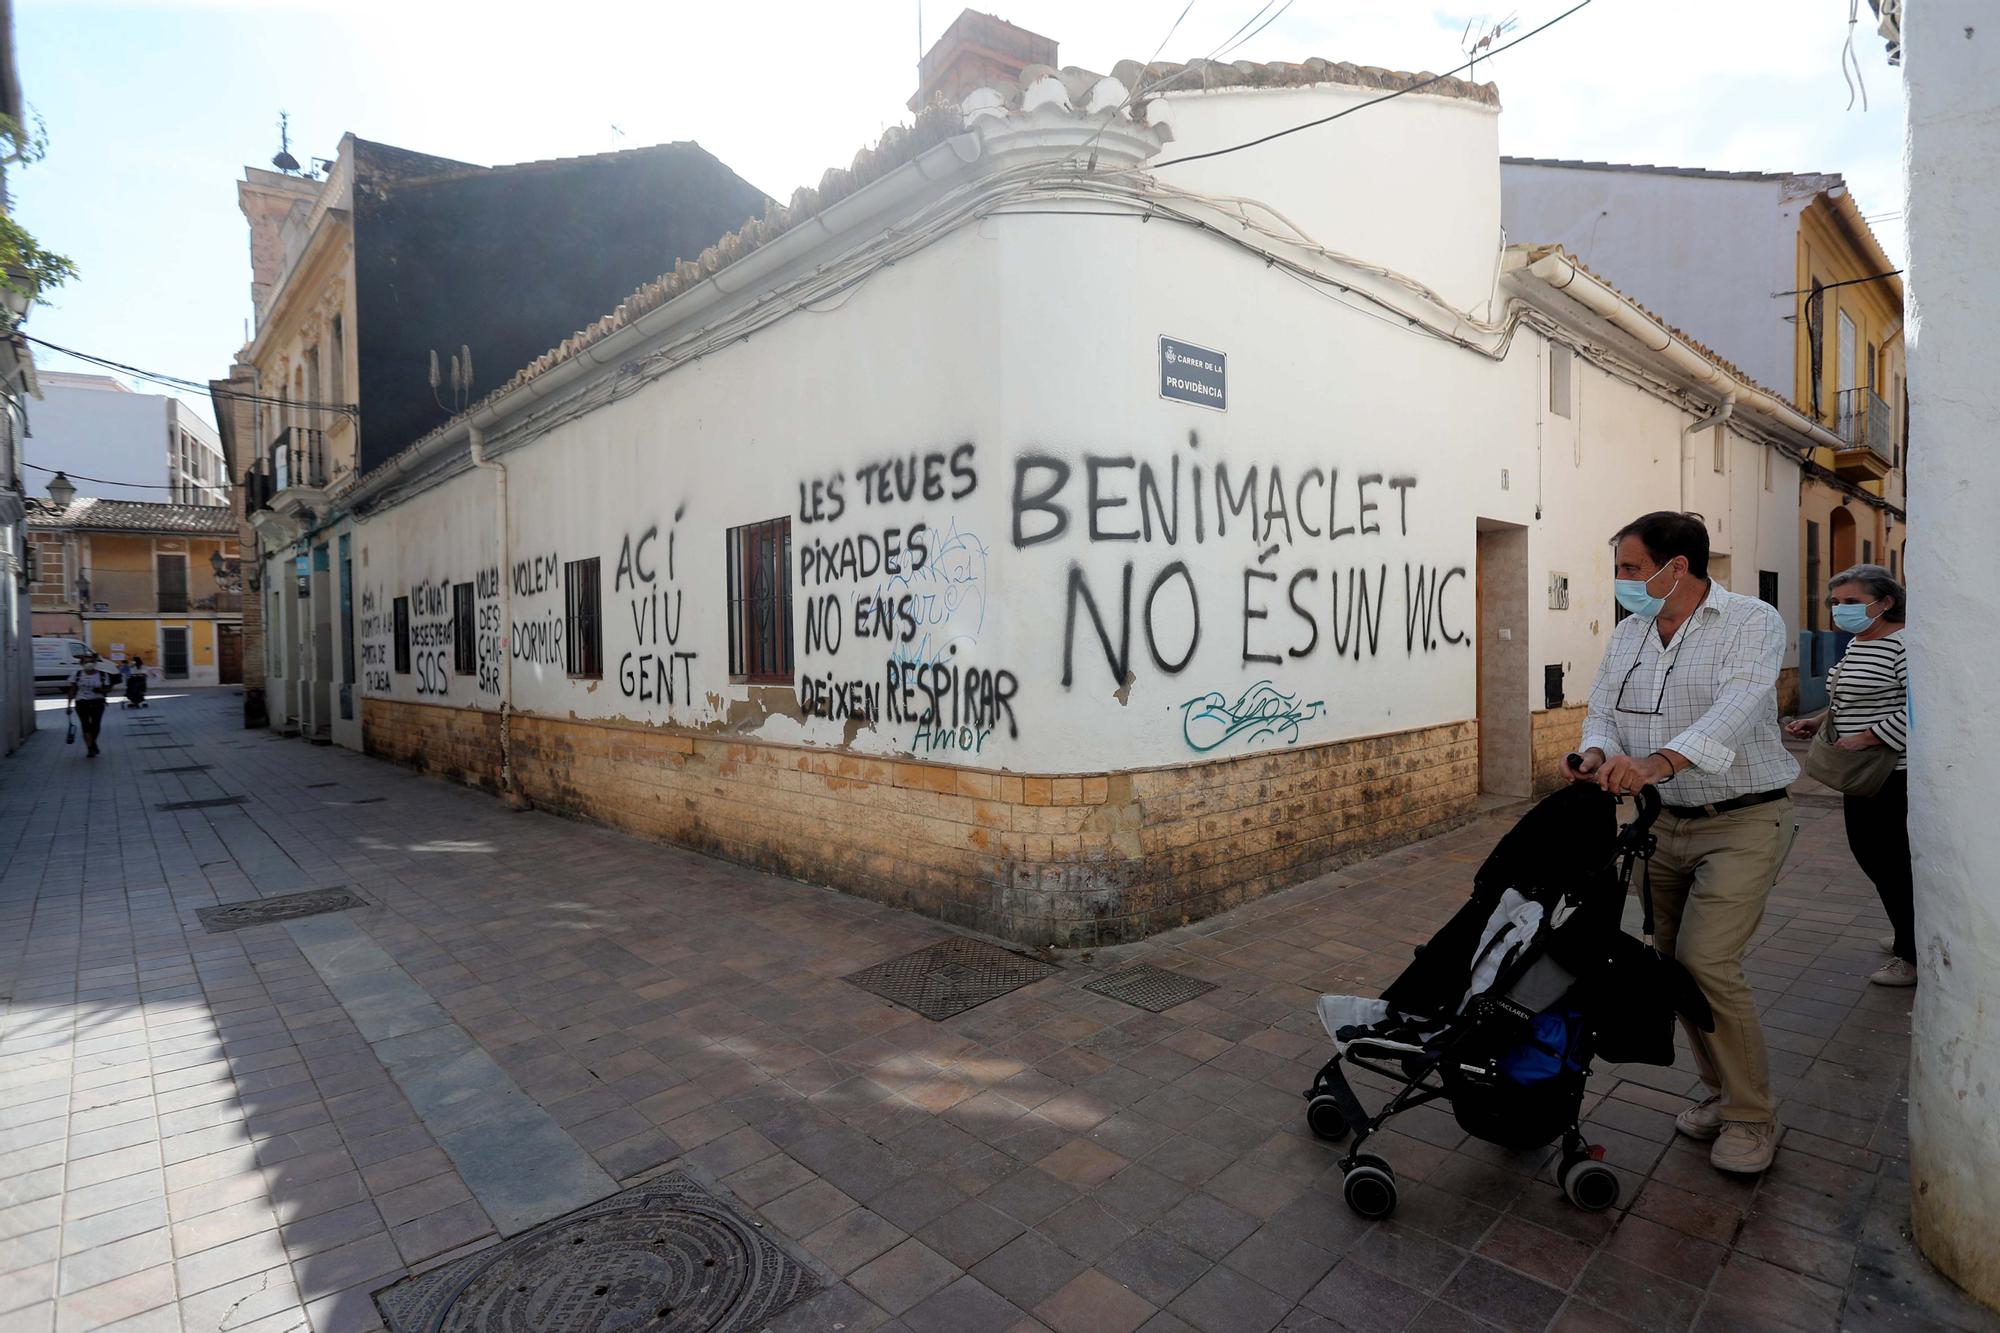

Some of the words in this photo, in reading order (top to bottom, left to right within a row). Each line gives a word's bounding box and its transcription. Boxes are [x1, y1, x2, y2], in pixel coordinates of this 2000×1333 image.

[1166, 375, 1223, 399] PROVIDÈNCIA
[1177, 354, 1203, 369] CARRER
[1204, 362, 1214, 371] DE
[1214, 364, 1223, 374] LA
[799, 470, 847, 525] LES
[512, 551, 559, 598] VOLEM
[479, 604, 500, 632] DES
[512, 609, 564, 671] DORMIR
[804, 594, 842, 657] NO
[853, 592, 917, 643] ENS
[1061, 559, 1202, 688] NO
[1242, 543, 1320, 670] ÉS
[1332, 562, 1387, 662] UN
[1404, 561, 1471, 653] W.C.
[479, 662, 500, 697] SAR
[620, 651, 698, 707] GENT
